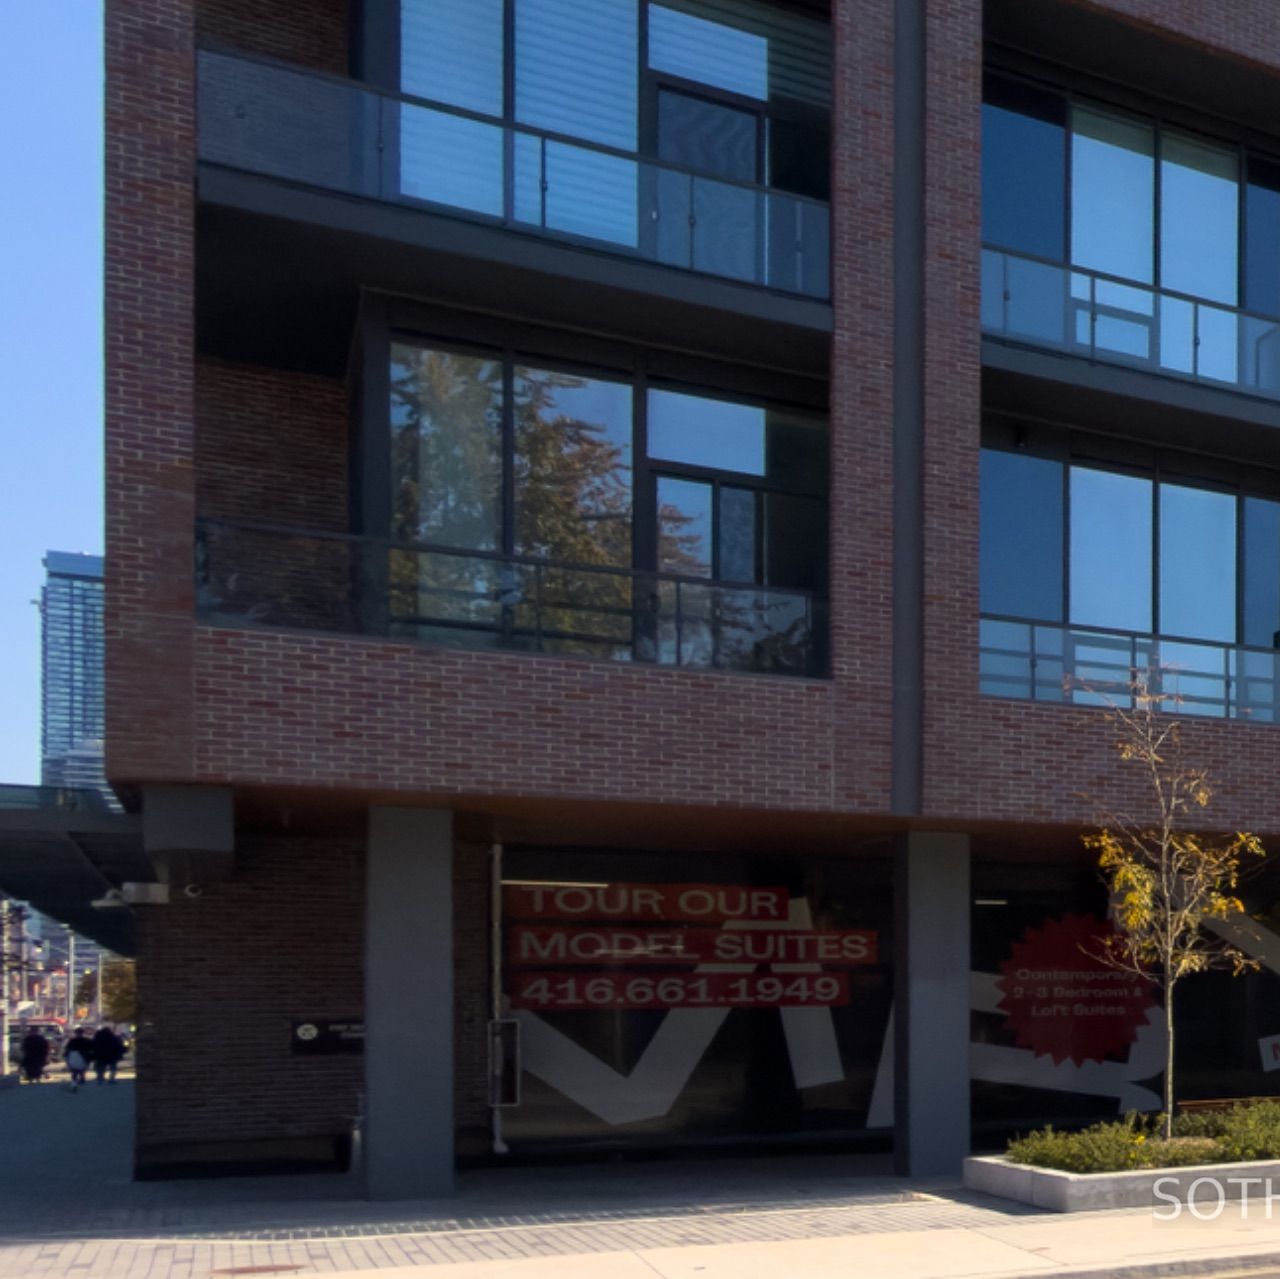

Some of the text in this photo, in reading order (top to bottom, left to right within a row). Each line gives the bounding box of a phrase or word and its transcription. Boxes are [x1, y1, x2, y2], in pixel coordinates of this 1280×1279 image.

[522, 886, 779, 917] TOUR OUR
[519, 930, 869, 960] MODEL SUITES
[520, 976, 841, 1006] 416.661.1949
[1053, 986, 1128, 998] Bedroom
[1031, 1004, 1126, 1017] Loft Suites
